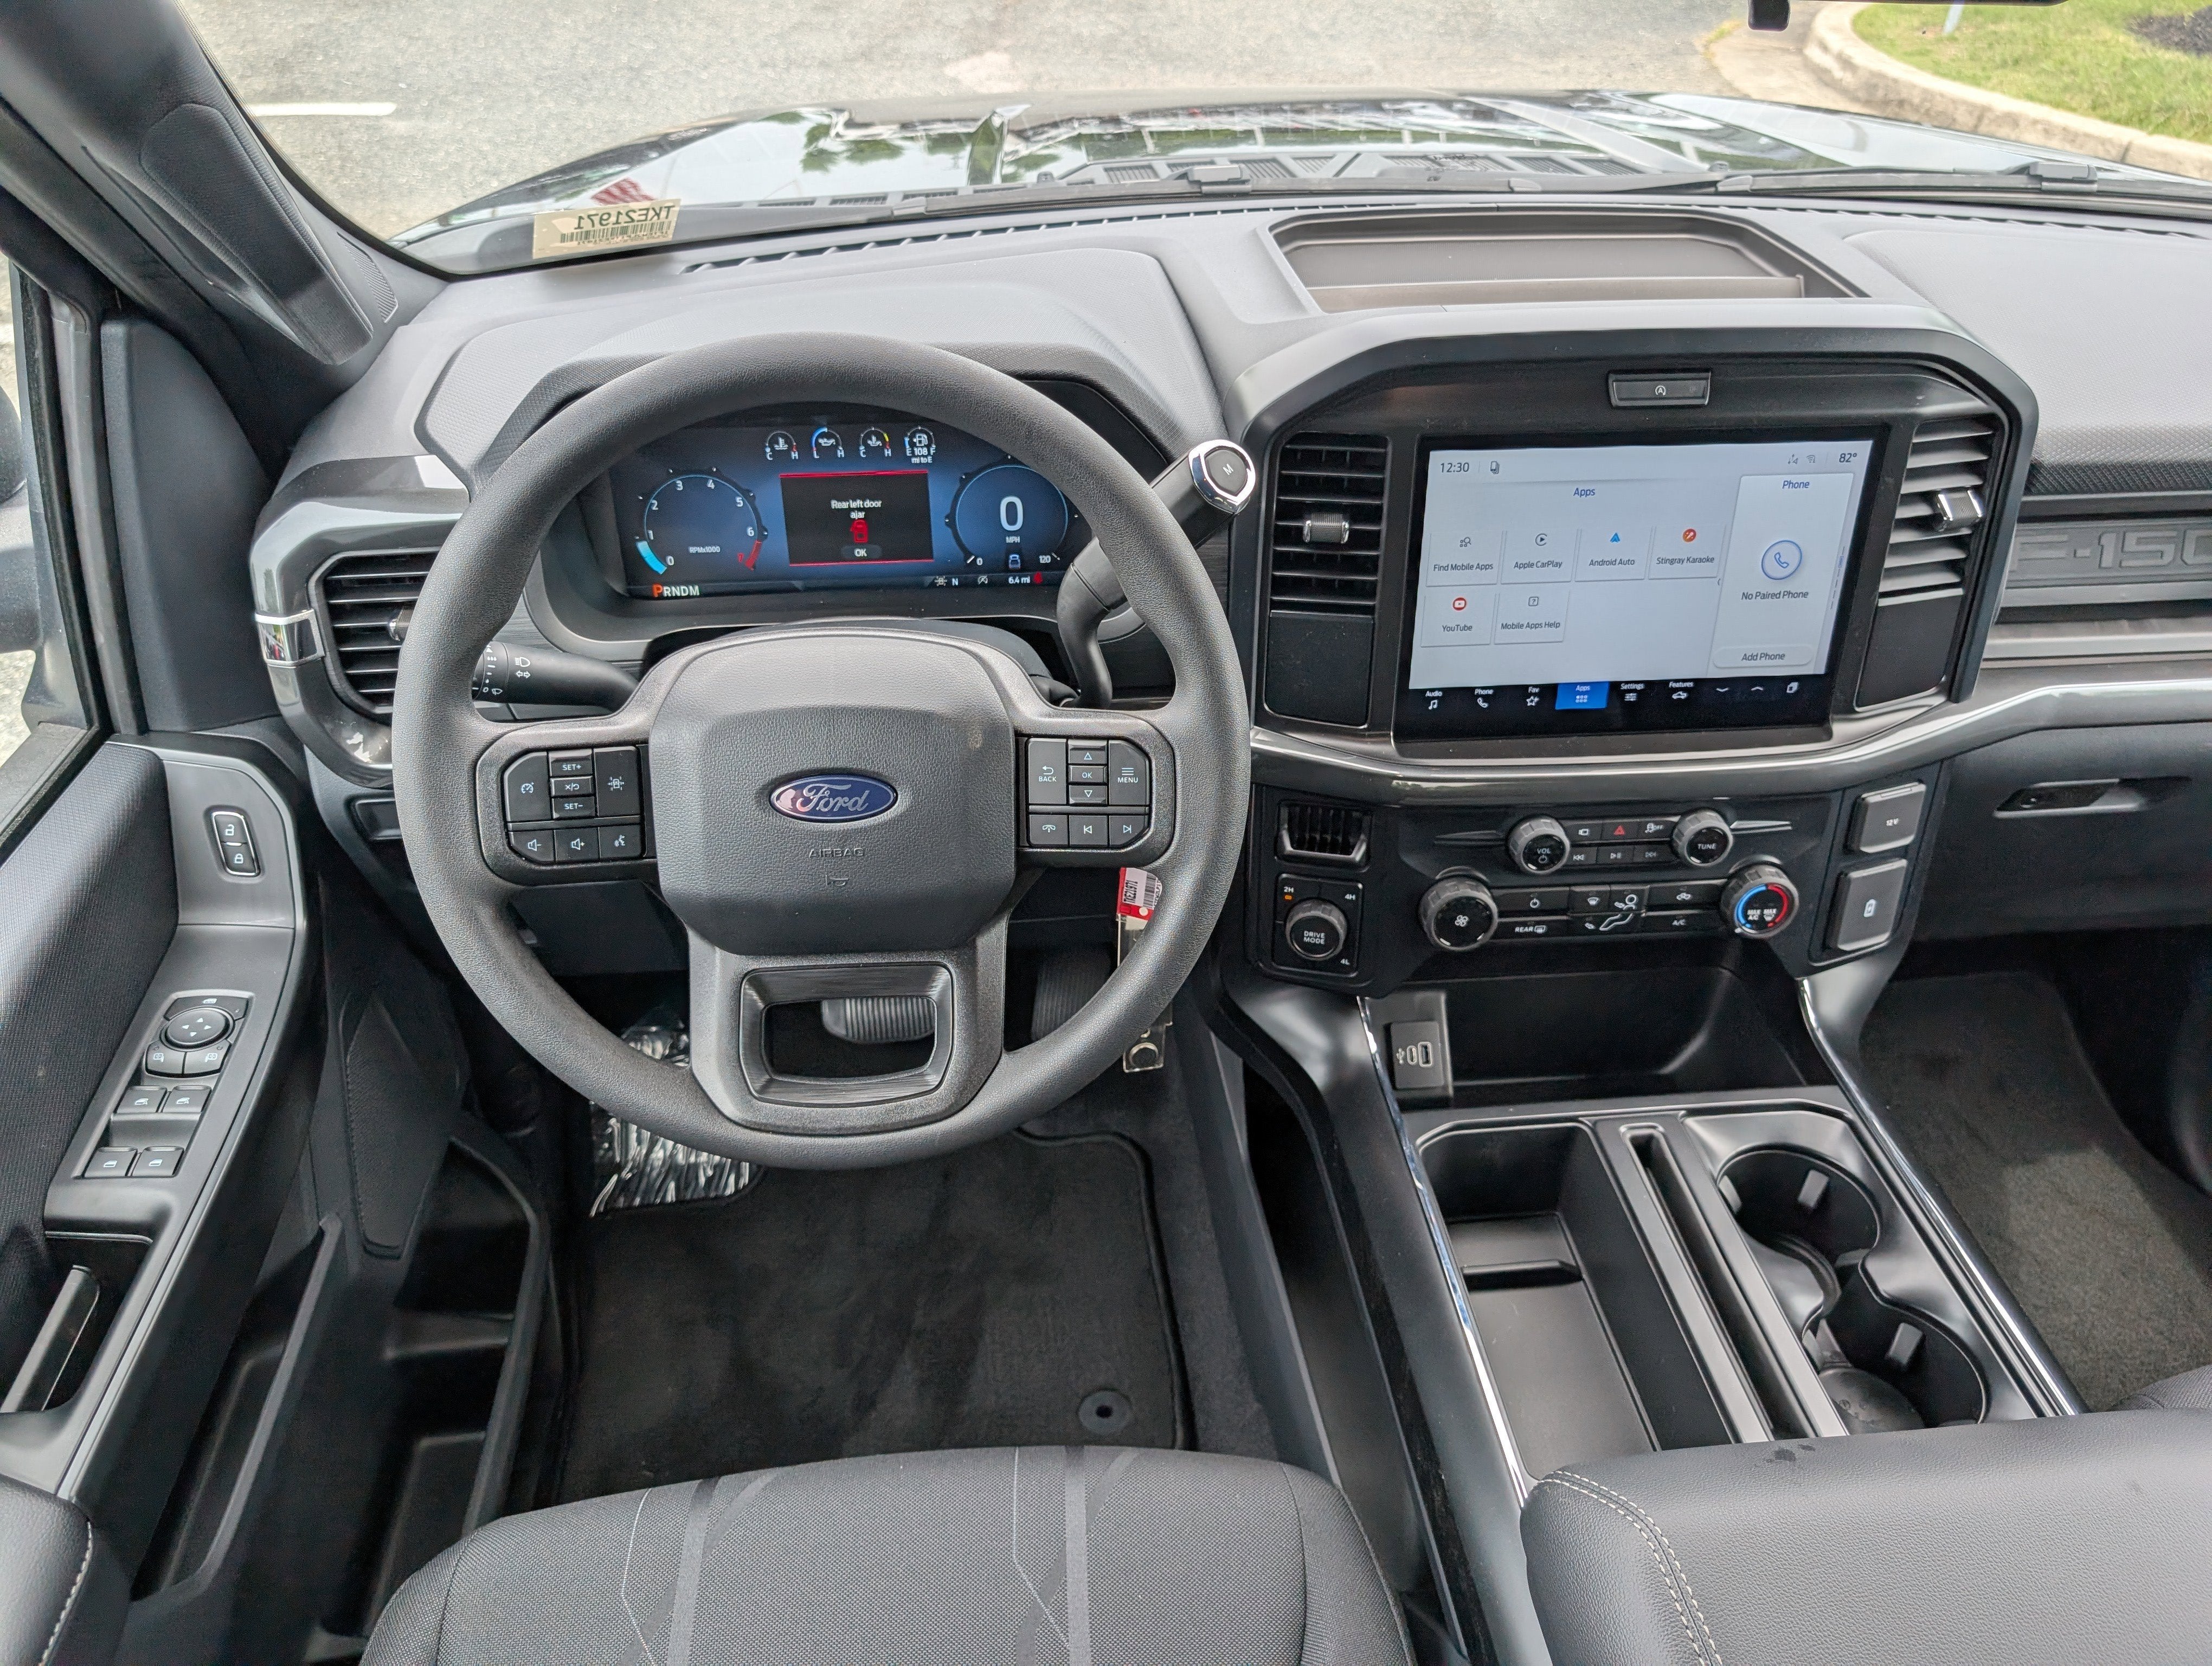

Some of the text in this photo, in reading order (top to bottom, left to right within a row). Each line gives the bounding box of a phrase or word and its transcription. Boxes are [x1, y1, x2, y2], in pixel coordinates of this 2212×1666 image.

[906, 448, 912, 456] E
[914, 447, 928, 456] 108
[1839, 453, 1857, 463] 82°
[1223, 463, 1234, 476] M
[1440, 462, 1469, 473] 12:30
[676, 480, 683, 490] 3
[706, 479, 715, 489] 4
[1782, 480, 1810, 489] Phone
[1573, 488, 1595, 498] Apps
[651, 500, 658, 510] 2
[736, 496, 743, 507] 5
[831, 499, 882, 509] Rear left door
[850, 510, 865, 520] ajar
[1000, 496, 1023, 531] 0
[648, 529, 654, 540] 1
[747, 527, 754, 536] 6
[854, 548, 867, 557] OK
[666, 556, 674, 565] 0
[1039, 555, 1051, 563] 120
[1589, 558, 1617, 566] Android
[1656, 557, 1685, 566] Stingray
[1475, 563, 1493, 571] Apps
[1514, 560, 1562, 569] Apple CarPlay
[951, 578, 959, 586] N
[1741, 590, 1809, 600] No Paired Phone
[1525, 621, 1543, 630] Apps
[1544, 621, 1560, 629] Help
[1741, 652, 1785, 661] Add Phone
[796, 783, 870, 812] Ford
[809, 847, 864, 858] AIRBAG
[1124, 879, 1138, 904] TKE21971
[1303, 937, 1325, 945] MODE
